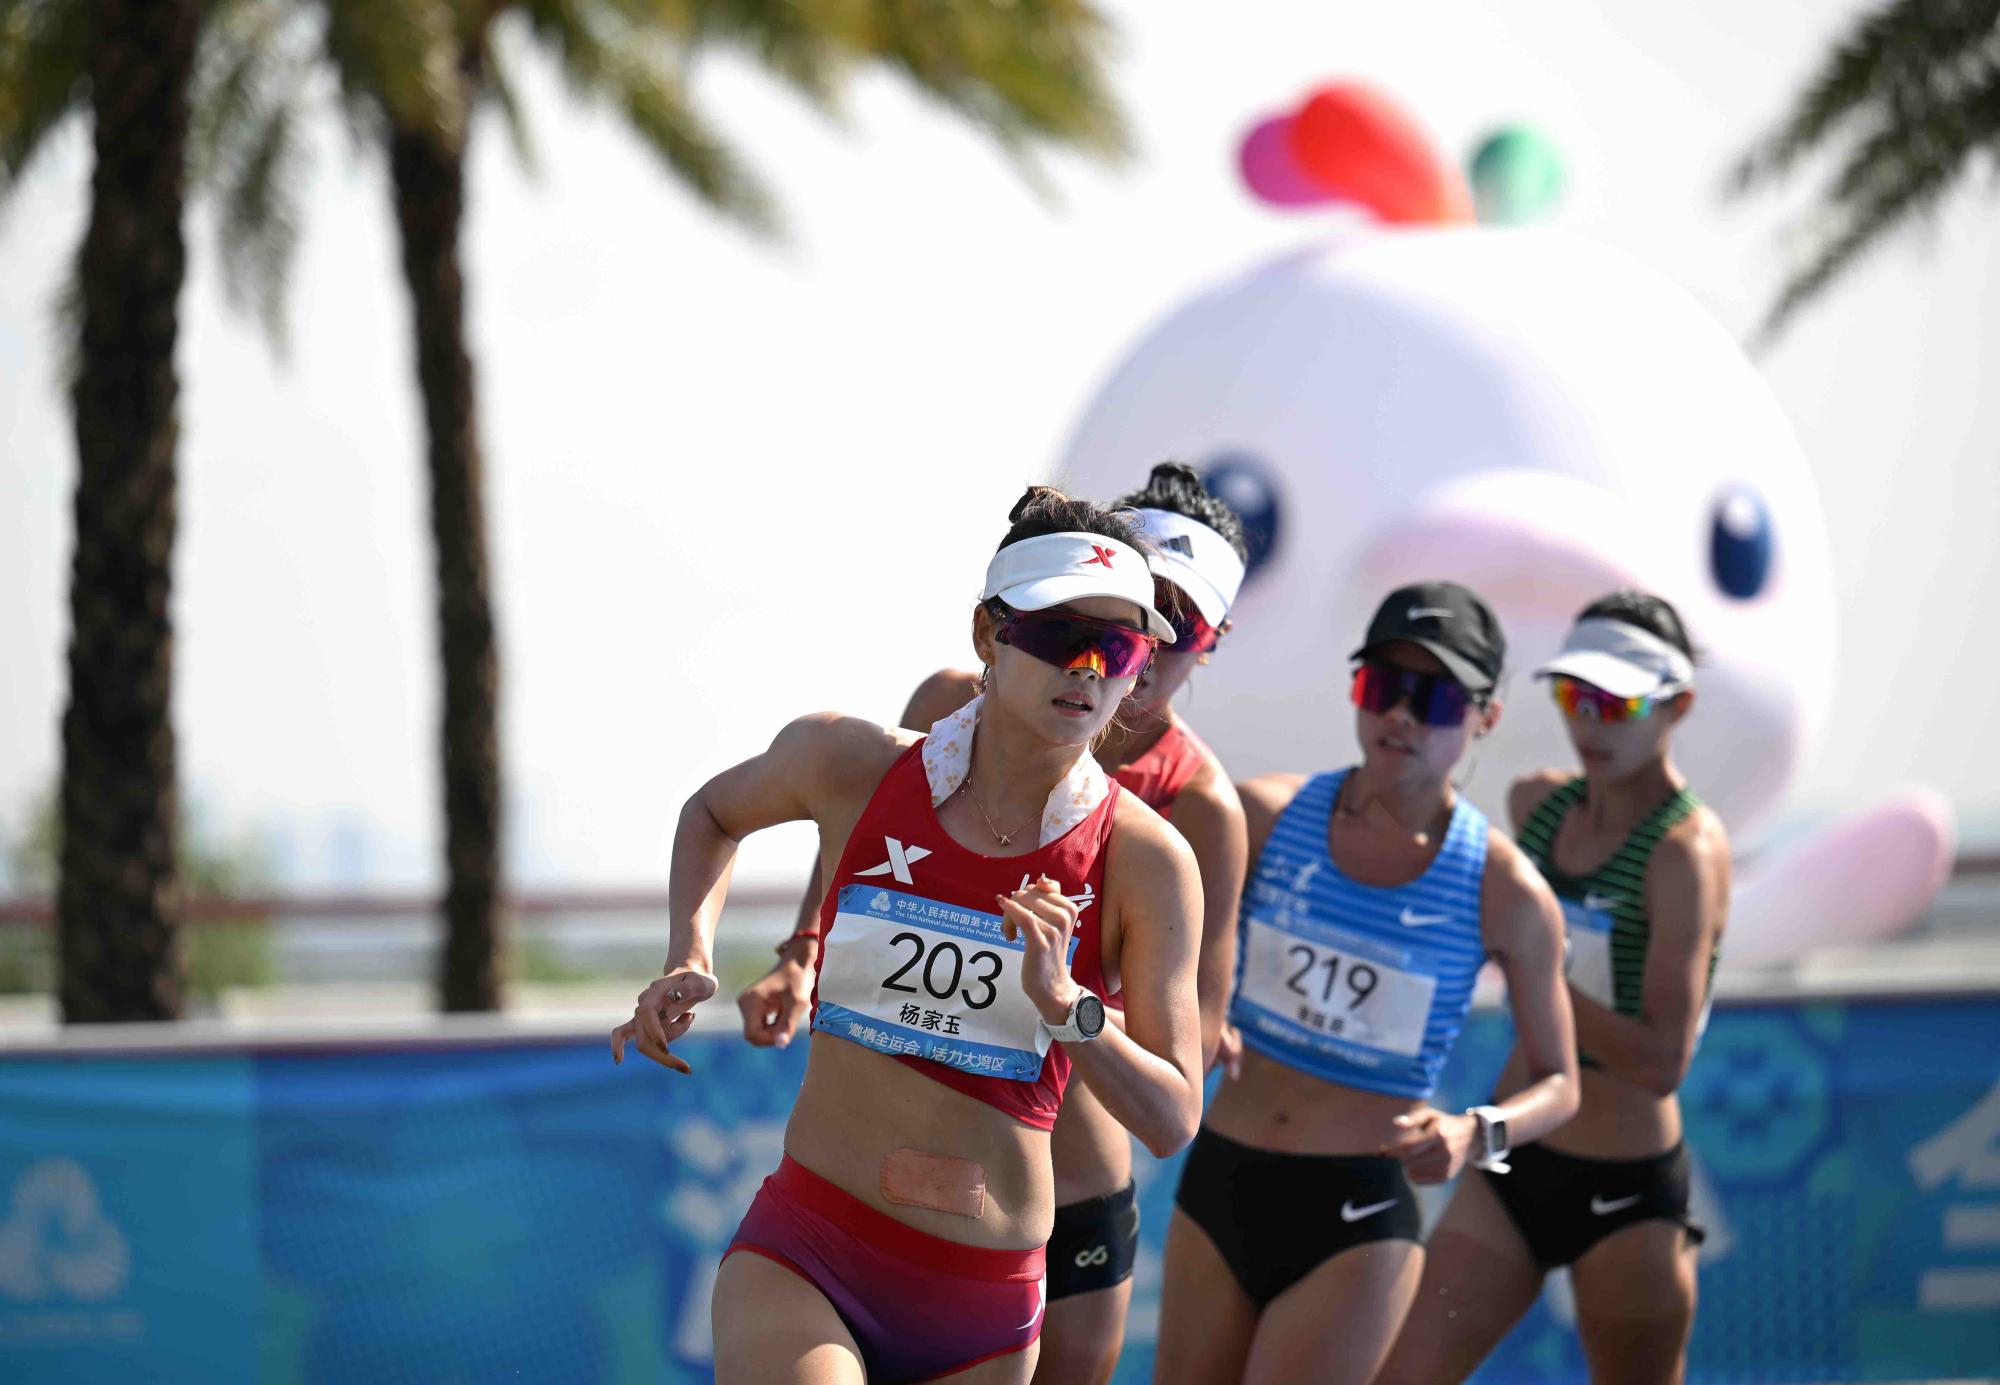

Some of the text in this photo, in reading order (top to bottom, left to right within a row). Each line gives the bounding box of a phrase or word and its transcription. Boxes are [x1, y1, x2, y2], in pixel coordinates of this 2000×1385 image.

[918, 916, 941, 925] National
[941, 921, 959, 930] Games
[881, 932, 1003, 1010] 203
[1287, 945, 1379, 1012] 219
[899, 1002, 962, 1035] 杨家玉
